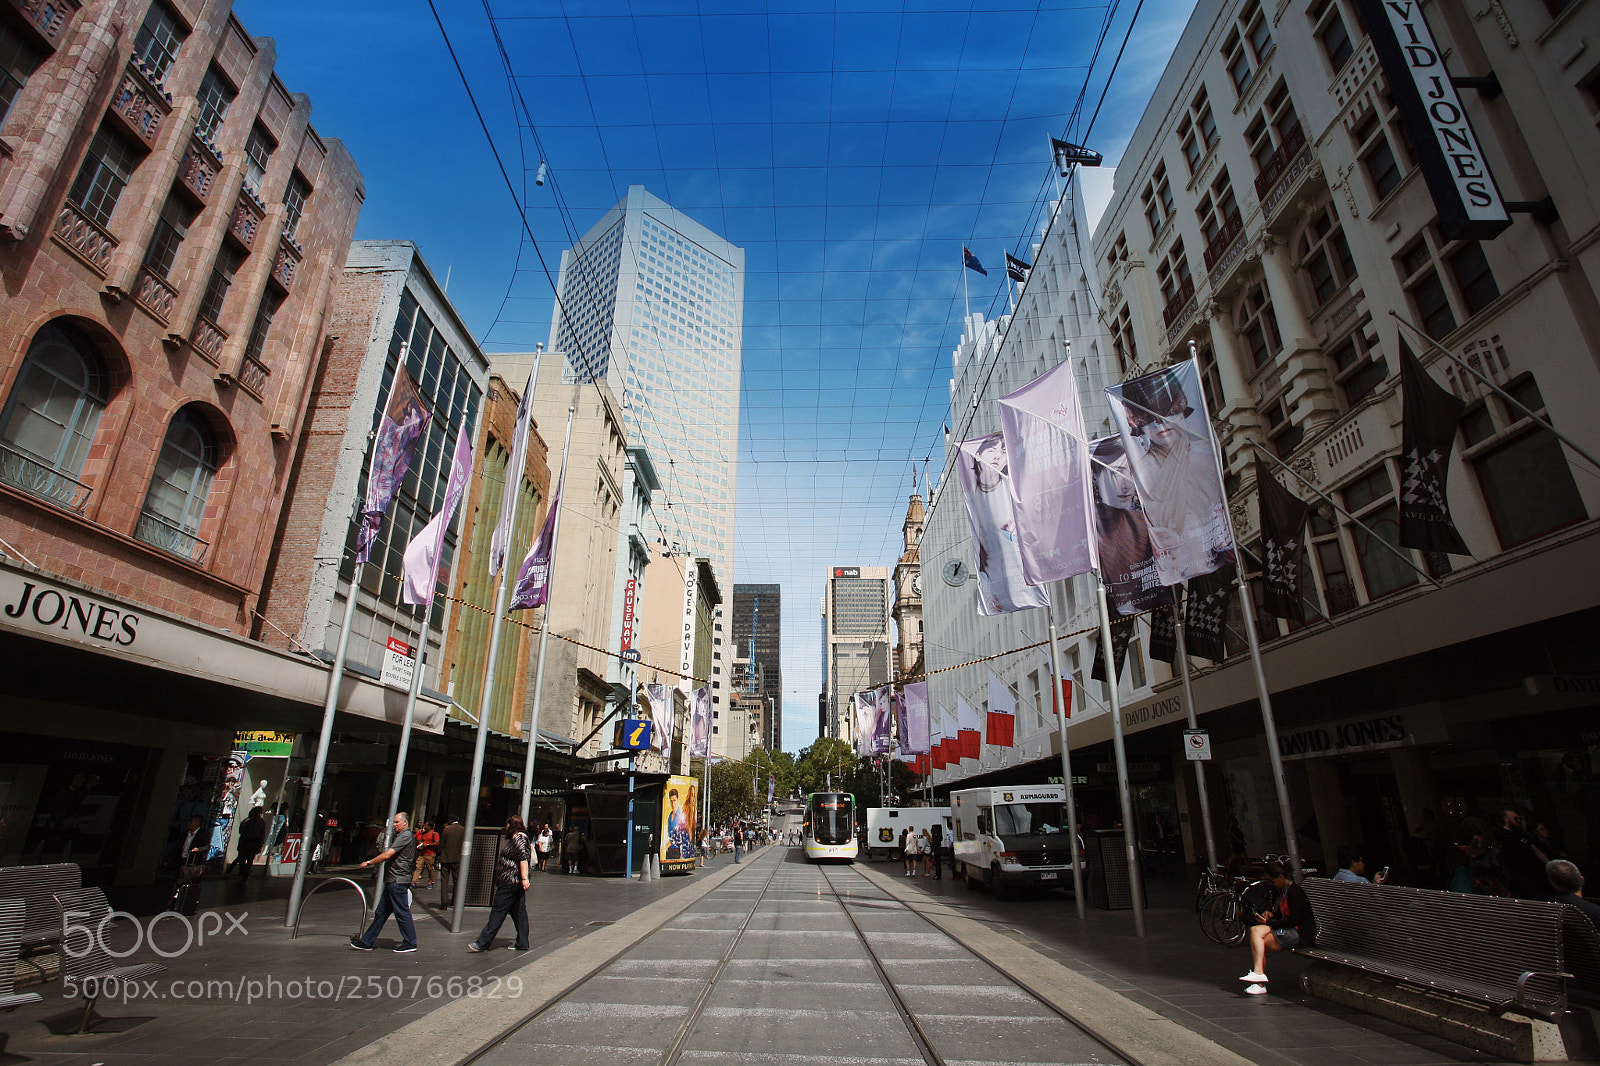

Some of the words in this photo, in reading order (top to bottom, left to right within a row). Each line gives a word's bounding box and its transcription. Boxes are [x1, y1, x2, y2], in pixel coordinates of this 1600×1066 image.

[1386, 2, 1437, 67] VID
[1428, 76, 1492, 207] JONES
[1267, 157, 1305, 211] LIMITED
[686, 571, 694, 616] ROGER
[844, 568, 858, 576] nab
[5, 582, 140, 646] JONES
[623, 581, 634, 645] CAUSEWAY
[392, 653, 403, 665] FOR
[403, 658, 416, 668] LEA
[682, 623, 690, 670] DAVID
[1125, 707, 1150, 727] DAVID
[1151, 695, 1181, 720] JONES
[1278, 729, 1330, 756] DAVID
[1335, 715, 1406, 749] JONES
[284, 839, 301, 861] 70
